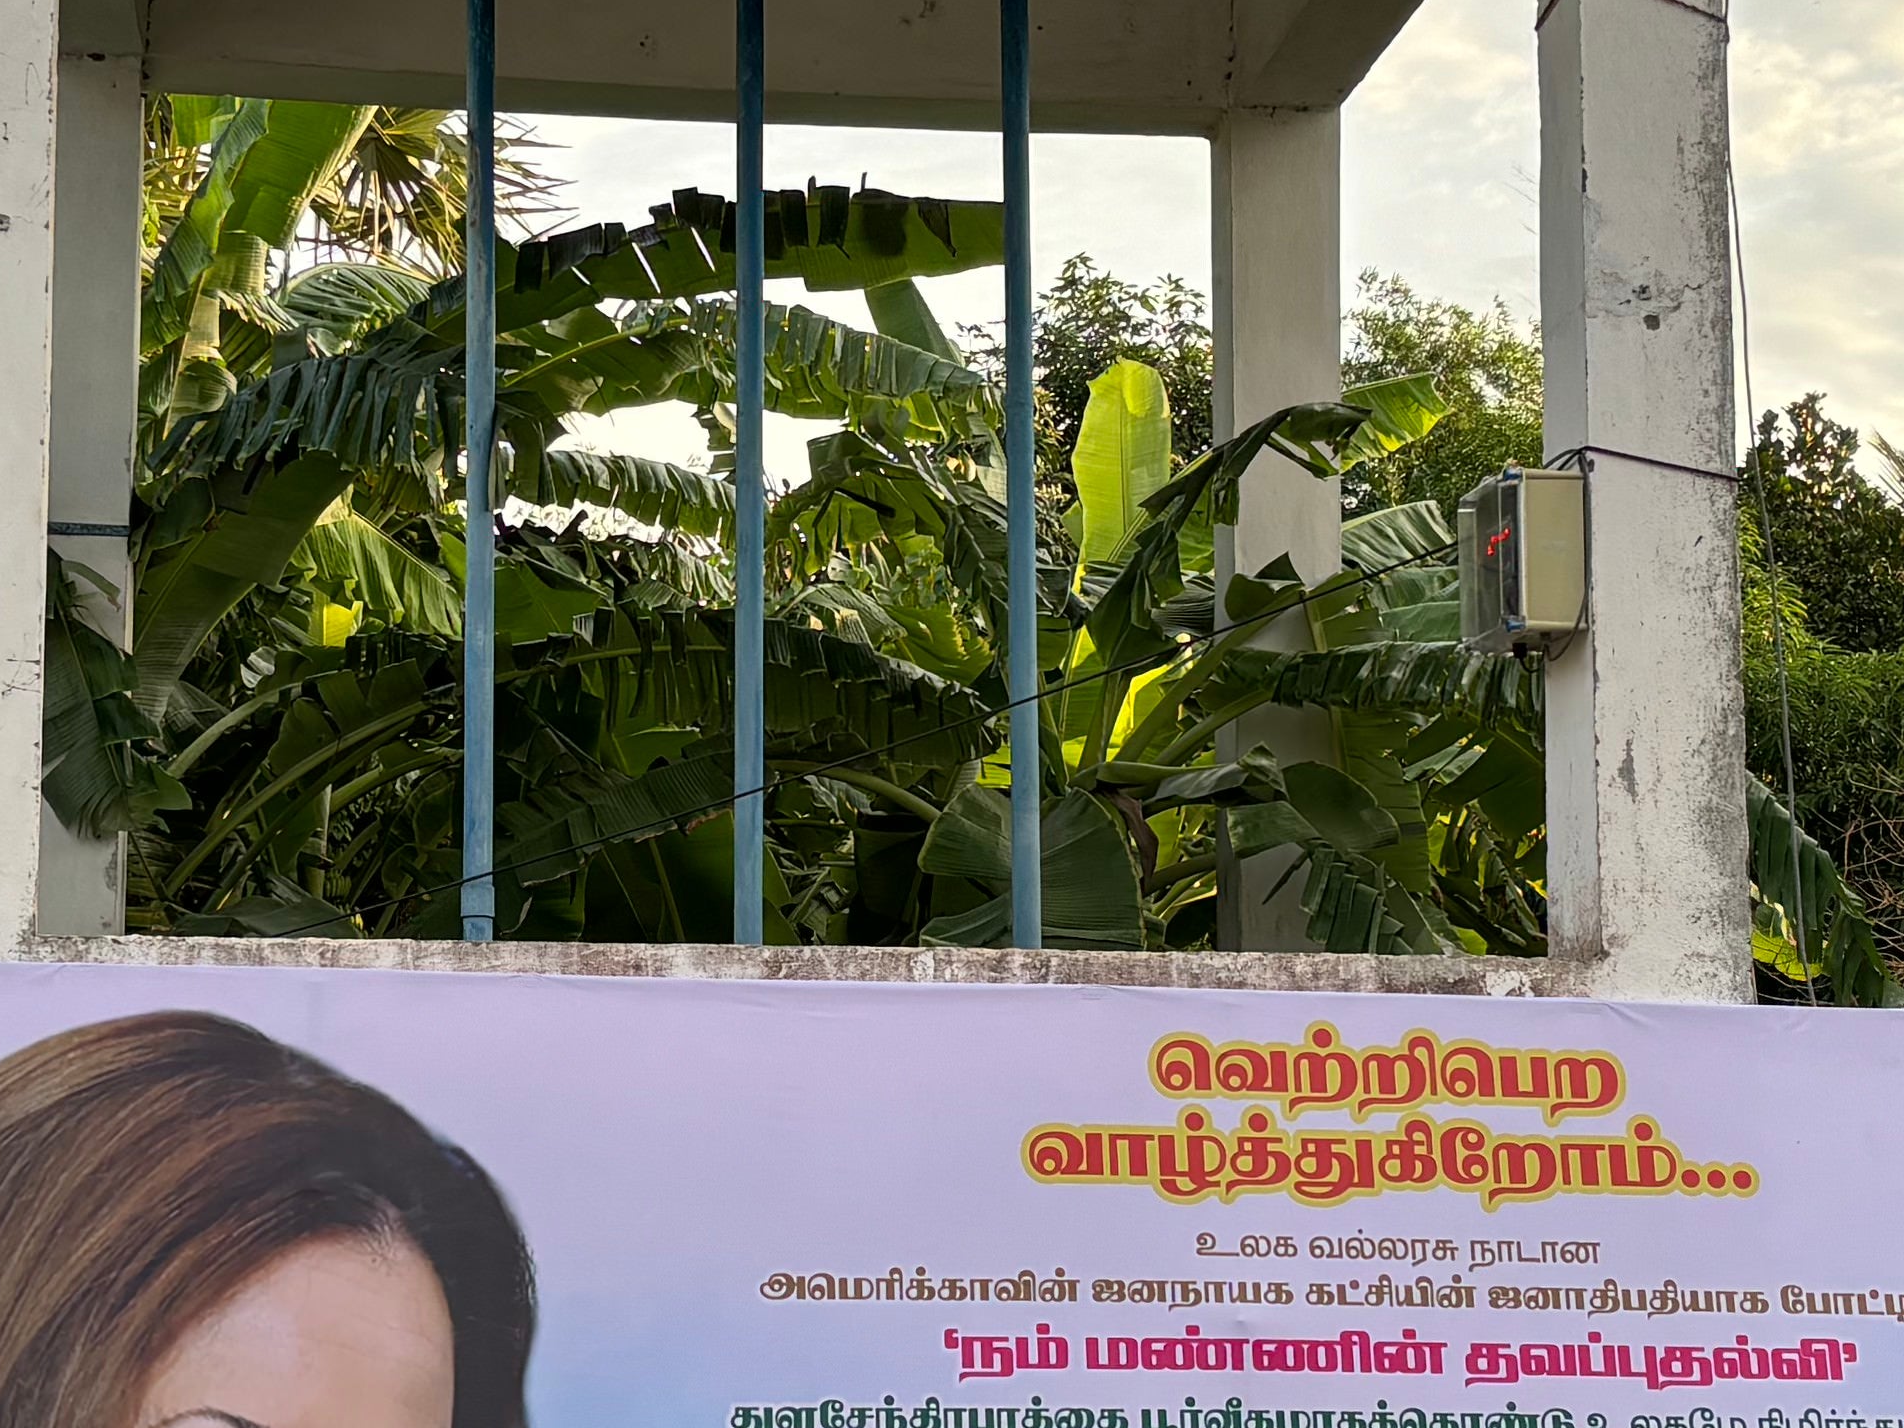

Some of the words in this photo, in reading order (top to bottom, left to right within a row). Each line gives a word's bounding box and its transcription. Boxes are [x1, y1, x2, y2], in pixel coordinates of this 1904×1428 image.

[1155, 1028, 1620, 1118] வெற்றிபெற
[1031, 1112, 1754, 1204] வாழ்த்துகிறோம்...
[1195, 1232, 1298, 1260] உலக
[1307, 1233, 1458, 1268] வல்லரசு
[1469, 1237, 1601, 1272] நாடான
[759, 1266, 1080, 1304] அமெரிக்காவின்
[1090, 1275, 1294, 1312] ஜனநாயக
[1305, 1273, 1476, 1307] கட்சியின்
[1487, 1278, 1770, 1319] ஜனாதிபதியாக
[1085, 1325, 1448, 1376] மண்ணின்
